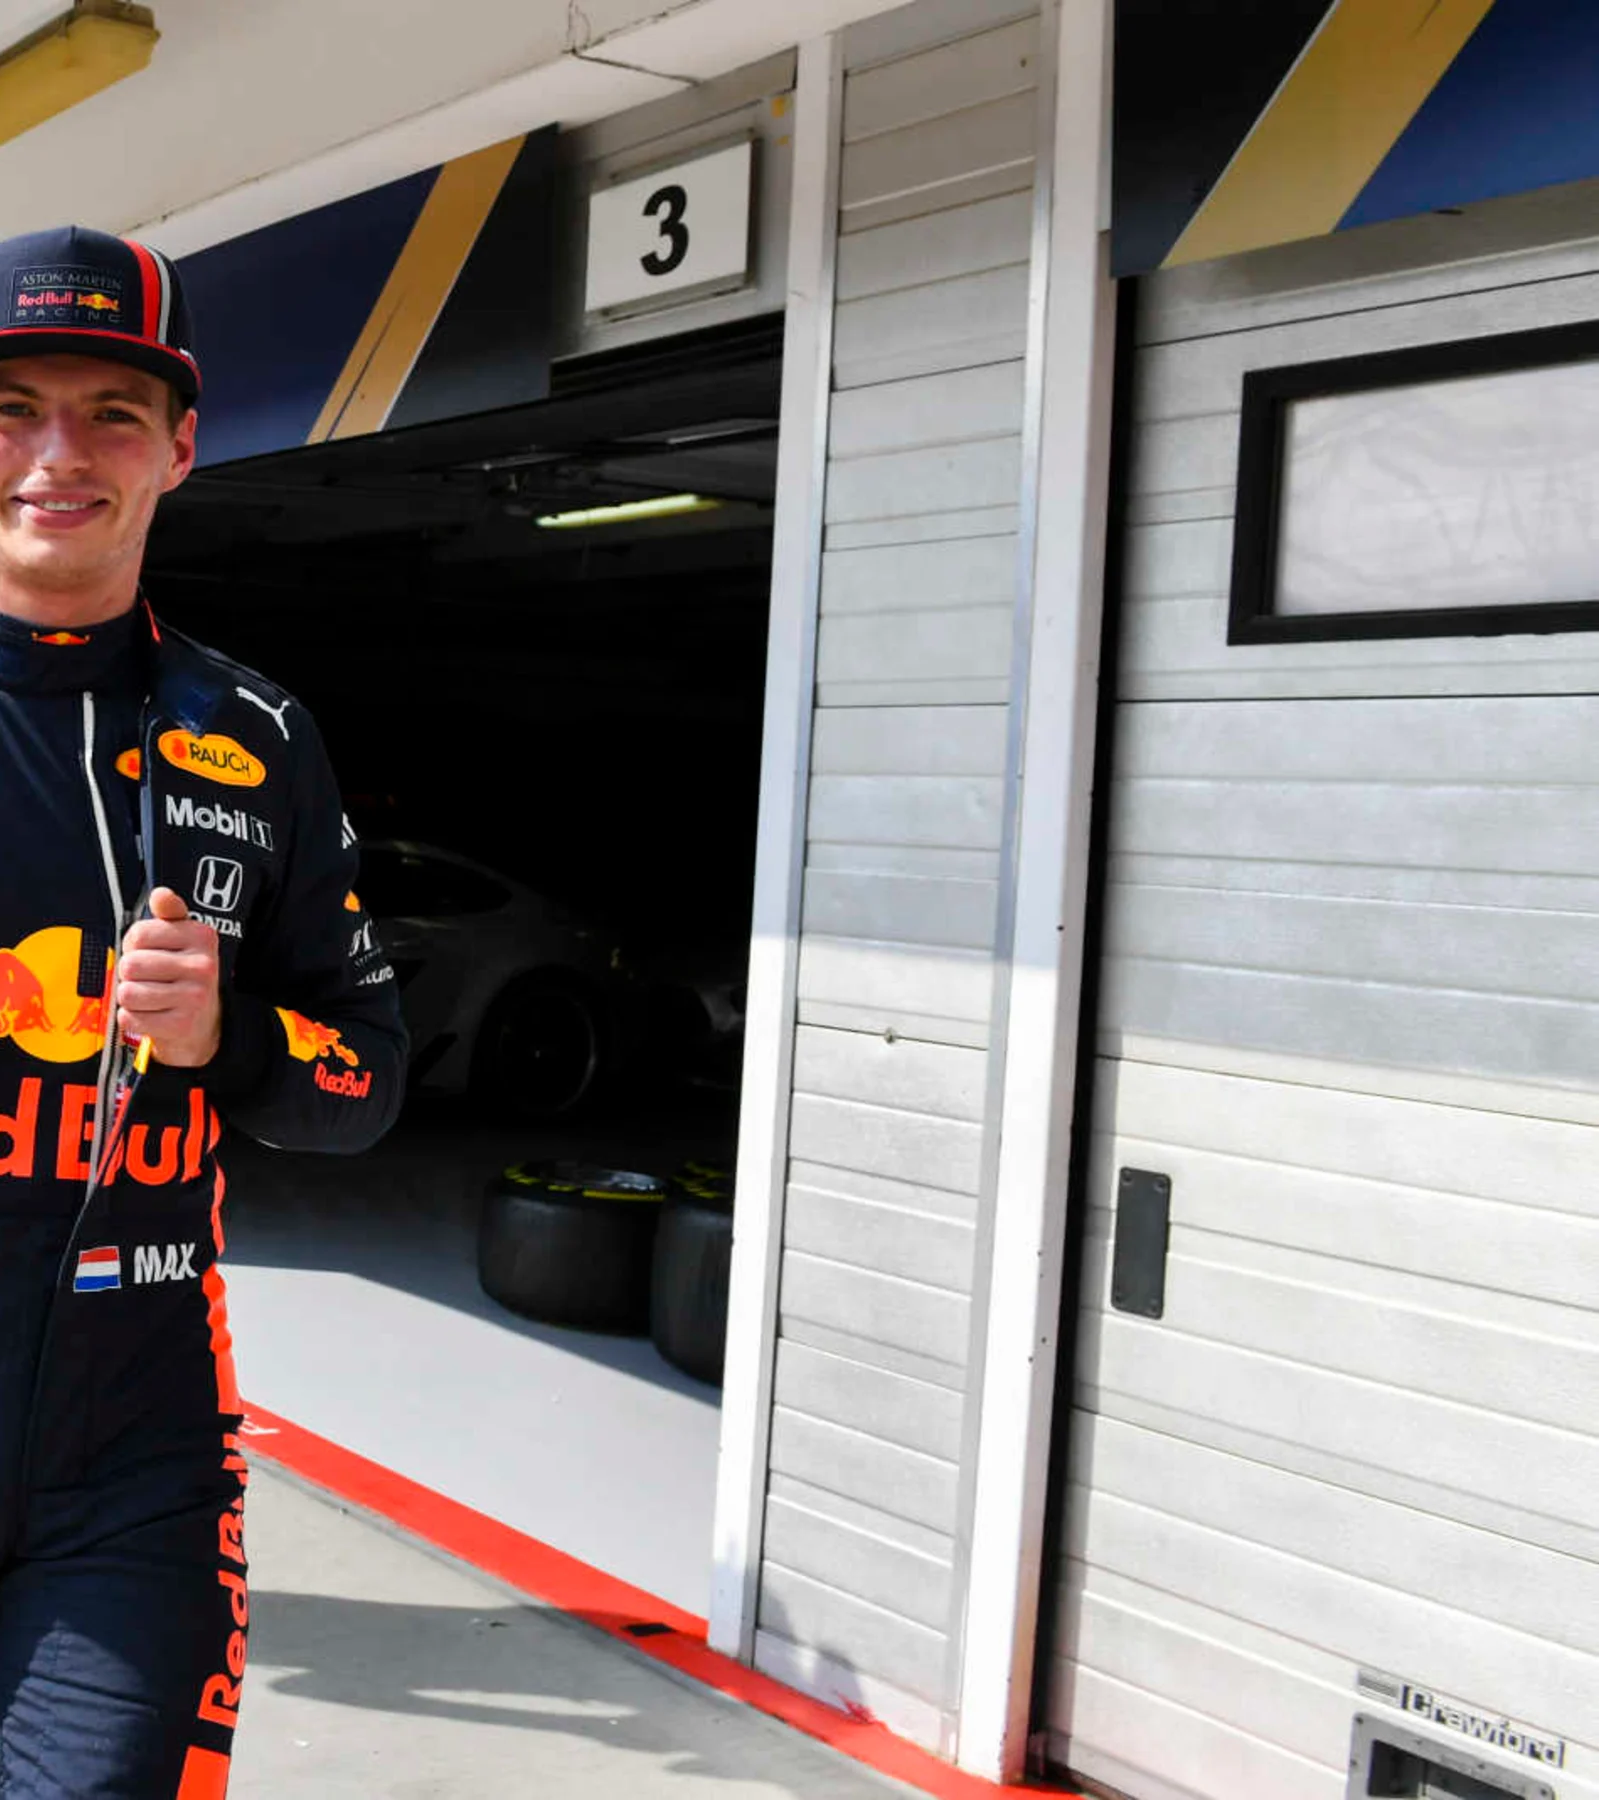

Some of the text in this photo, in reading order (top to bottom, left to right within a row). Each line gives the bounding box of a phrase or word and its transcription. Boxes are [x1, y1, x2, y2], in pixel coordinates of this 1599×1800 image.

[640, 184, 689, 276] 3
[21, 272, 62, 285] ASTON
[189, 742, 250, 776] RAUCH
[166, 794, 248, 841] Mobil
[133, 1242, 198, 1284] MAX
